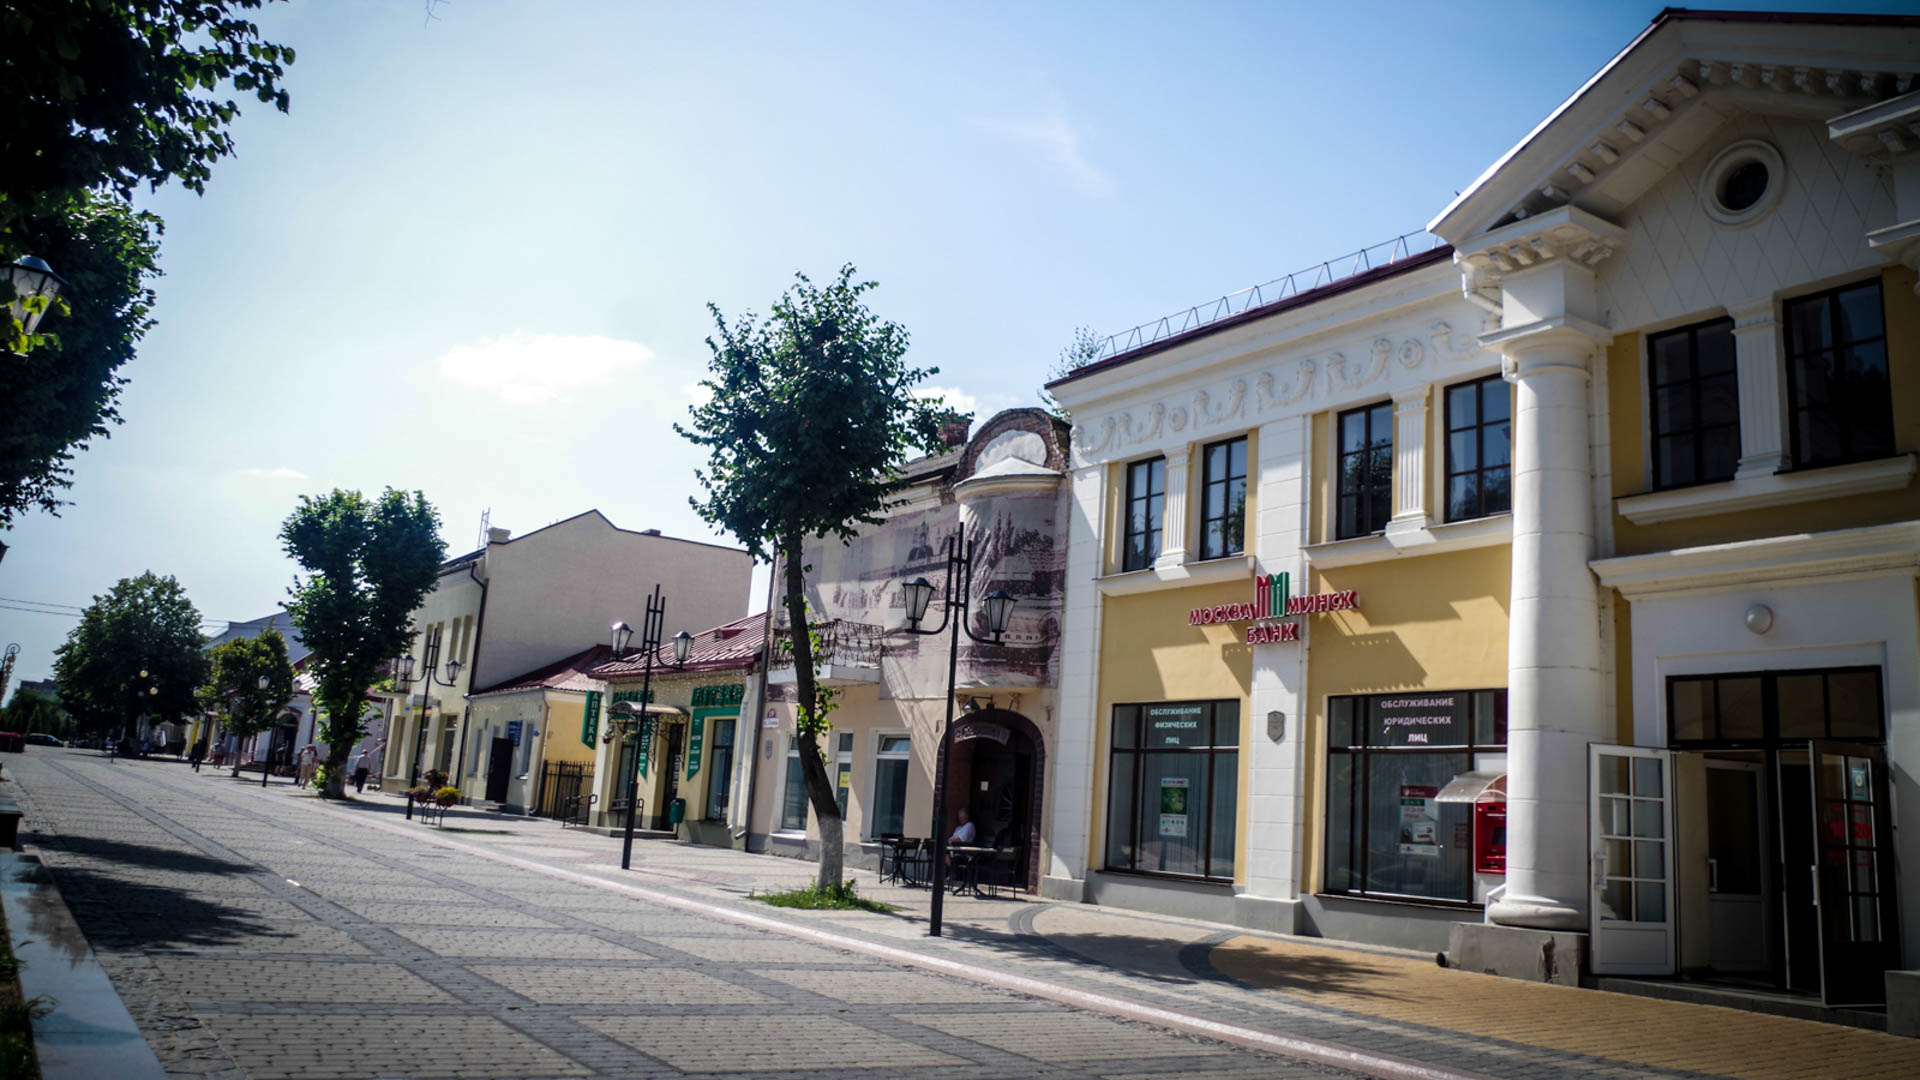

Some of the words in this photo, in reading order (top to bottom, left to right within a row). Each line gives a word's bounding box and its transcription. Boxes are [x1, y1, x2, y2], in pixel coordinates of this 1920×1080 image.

[1189, 602, 1257, 626] МОСКВА
[1286, 590, 1358, 615] МИНСК
[1246, 622, 1299, 645] БАНК
[1380, 697, 1455, 709] ОБСЛУЖИВАНИЕ
[1150, 706, 1202, 716] ОБСЛУЖИВАНИЕ
[587, 691, 599, 743] АПТЕКА
[1383, 715, 1452, 726] ЮРИДИЧЕСКИХ
[1154, 721, 1198, 729] ФИЗИЧЕСКИХ
[1165, 736, 1180, 745] ЛИЦ
[1407, 733, 1428, 743] ЛИЦ
